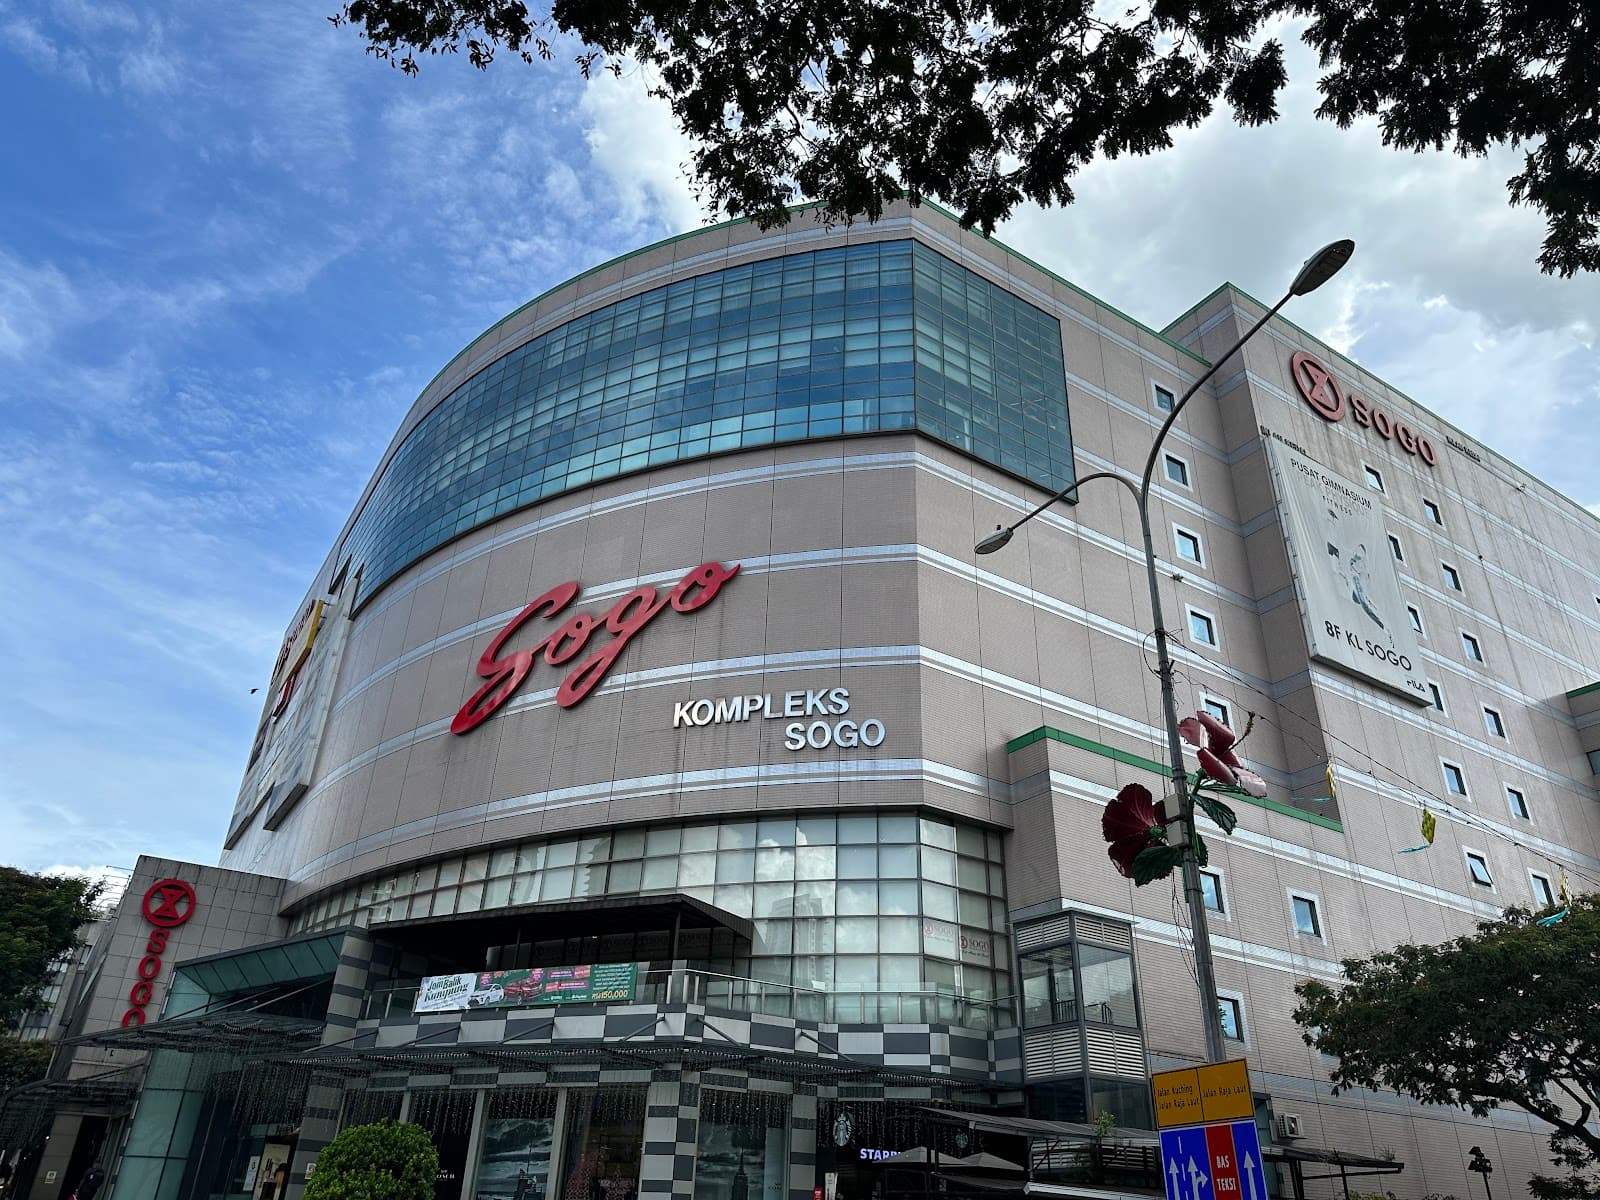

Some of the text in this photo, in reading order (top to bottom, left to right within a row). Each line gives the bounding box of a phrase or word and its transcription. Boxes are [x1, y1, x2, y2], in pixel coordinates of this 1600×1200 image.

[1350, 393, 1438, 466] SOGO
[1290, 457, 1320, 481] PUSAT
[1321, 475, 1372, 511] GIMNASIUM
[450, 561, 741, 735] Sogo
[1324, 620, 1412, 671] 8F KL SOGO
[672, 687, 850, 728] KOMPLEKS
[784, 718, 886, 751] SOGO
[121, 928, 170, 1028] SOGO
[1216, 1155, 1230, 1169] BAS
[1216, 1177, 1237, 1191] TEKSI
